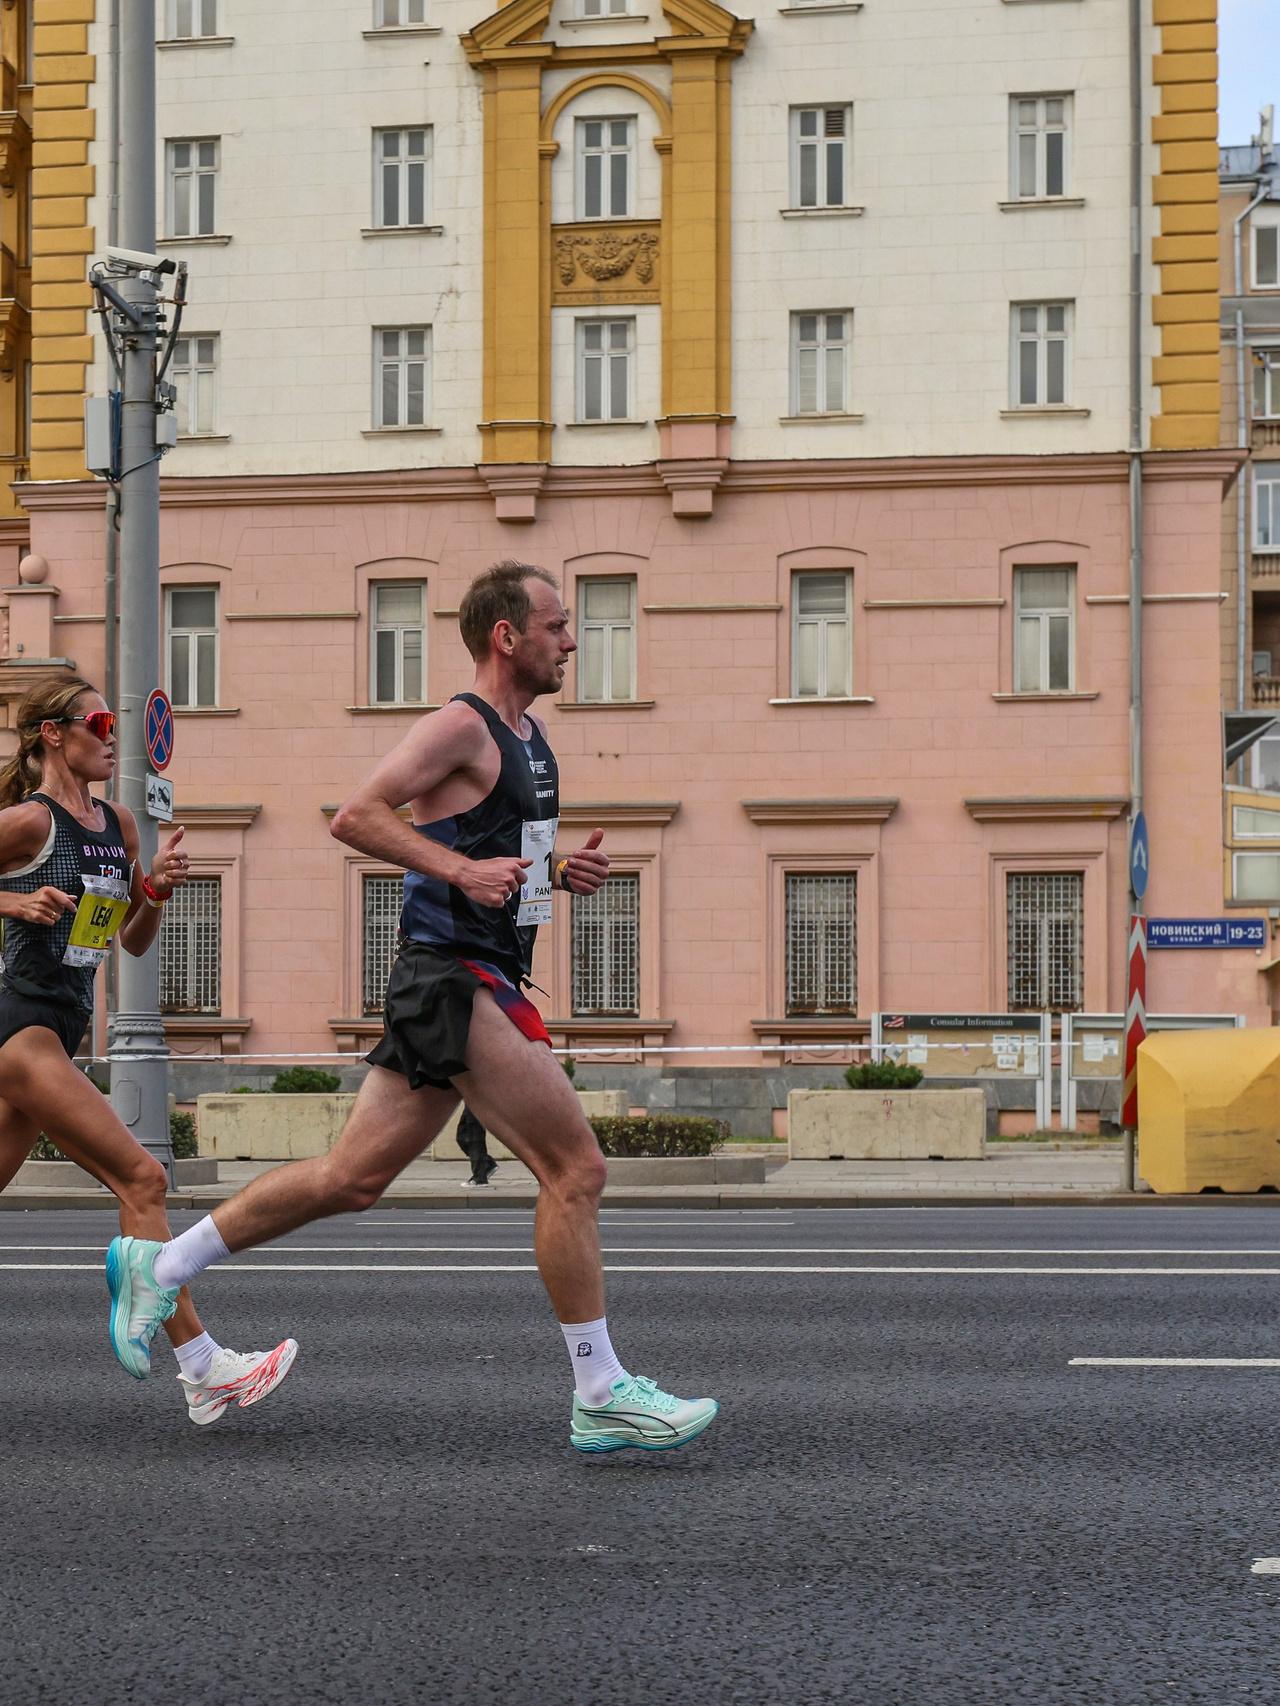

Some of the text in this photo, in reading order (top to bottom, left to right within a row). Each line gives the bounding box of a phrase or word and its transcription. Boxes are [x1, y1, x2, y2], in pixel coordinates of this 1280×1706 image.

[1151, 923, 1263, 939] НОВИНСКИЙ 19-23
[930, 1017, 1014, 1027] Consular Information
